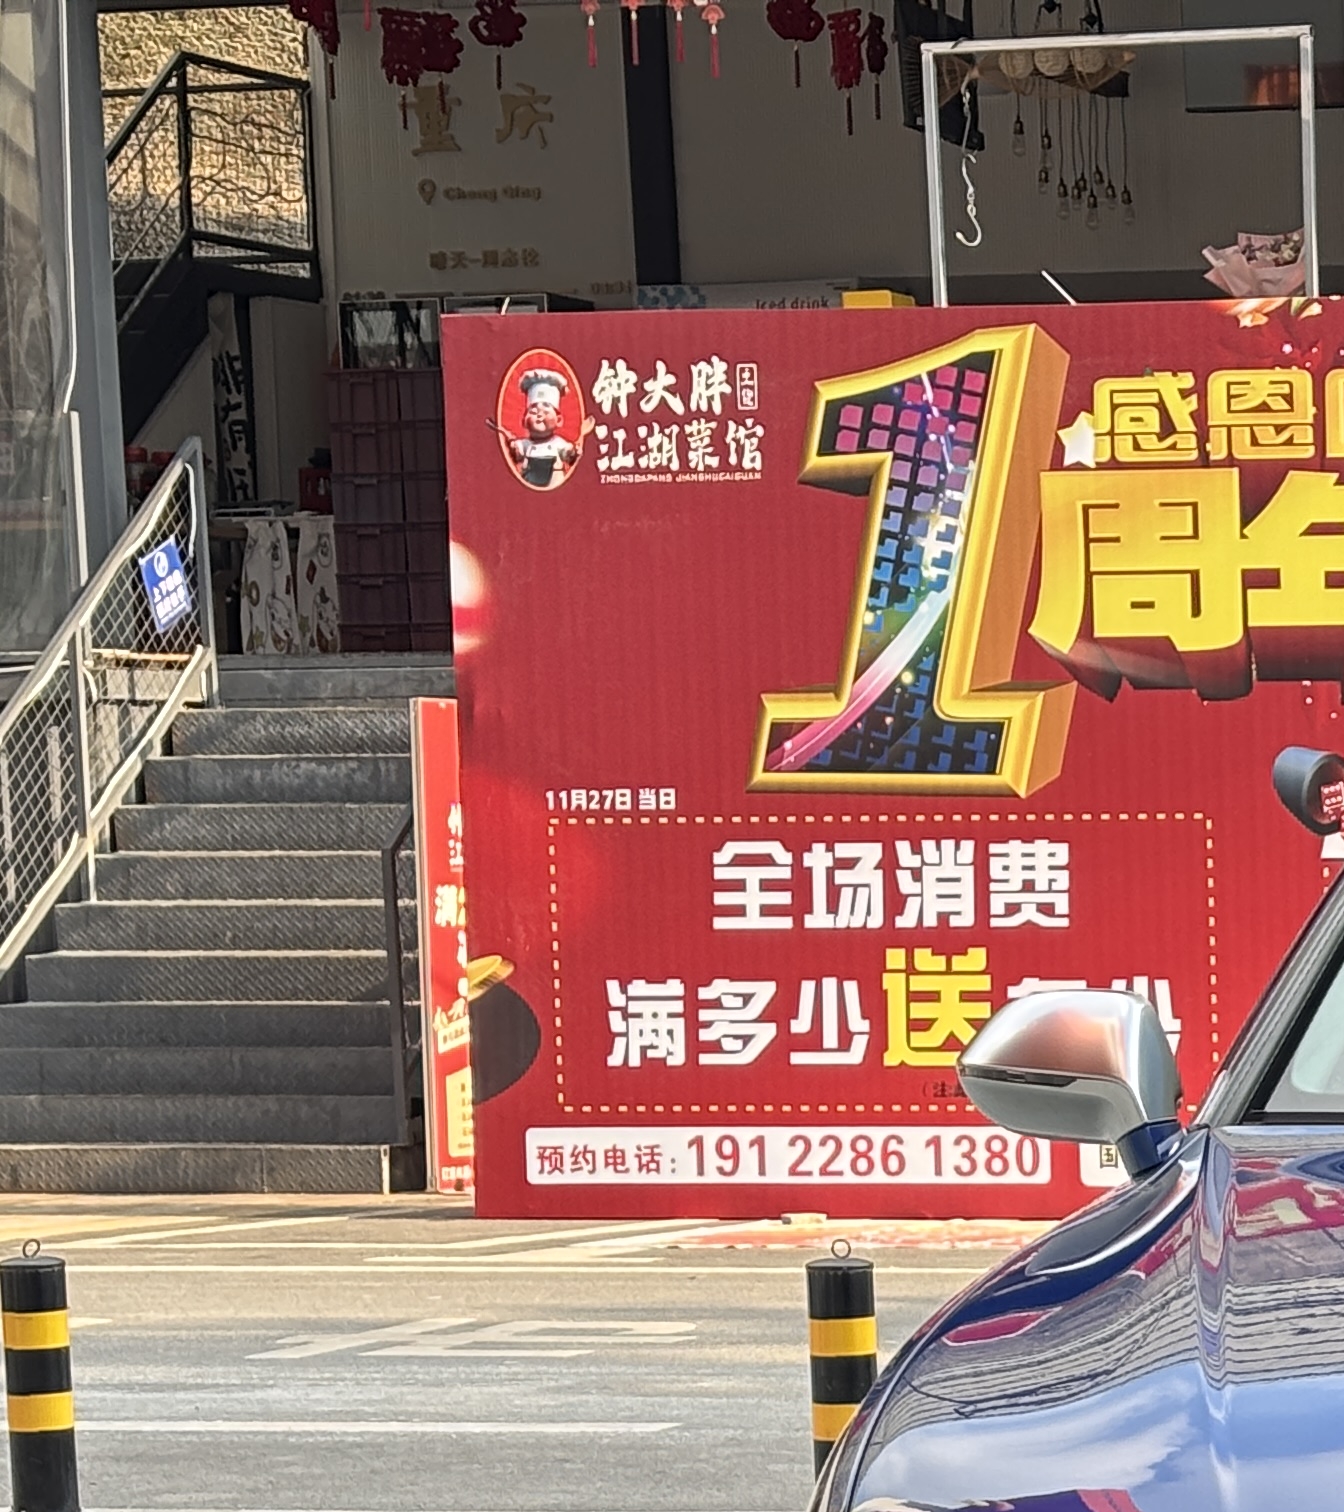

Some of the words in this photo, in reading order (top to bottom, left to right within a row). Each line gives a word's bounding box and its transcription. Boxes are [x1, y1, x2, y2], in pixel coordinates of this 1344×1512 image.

[592, 355, 733, 418] 钟大胖
[595, 418, 765, 472] 江湖菜馆
[745, 323, 1078, 800] 1
[545, 787, 632, 811] 11月27日
[638, 787, 677, 811] 当日
[711, 838, 1070, 930] 全场消费
[606, 946, 1182, 1068] 满多少送
[536, 1143, 677, 1177] 预约电话:
[686, 1134, 768, 1177] 191
[787, 1134, 906, 1178] 2286
[924, 1134, 1042, 1178] 1380
